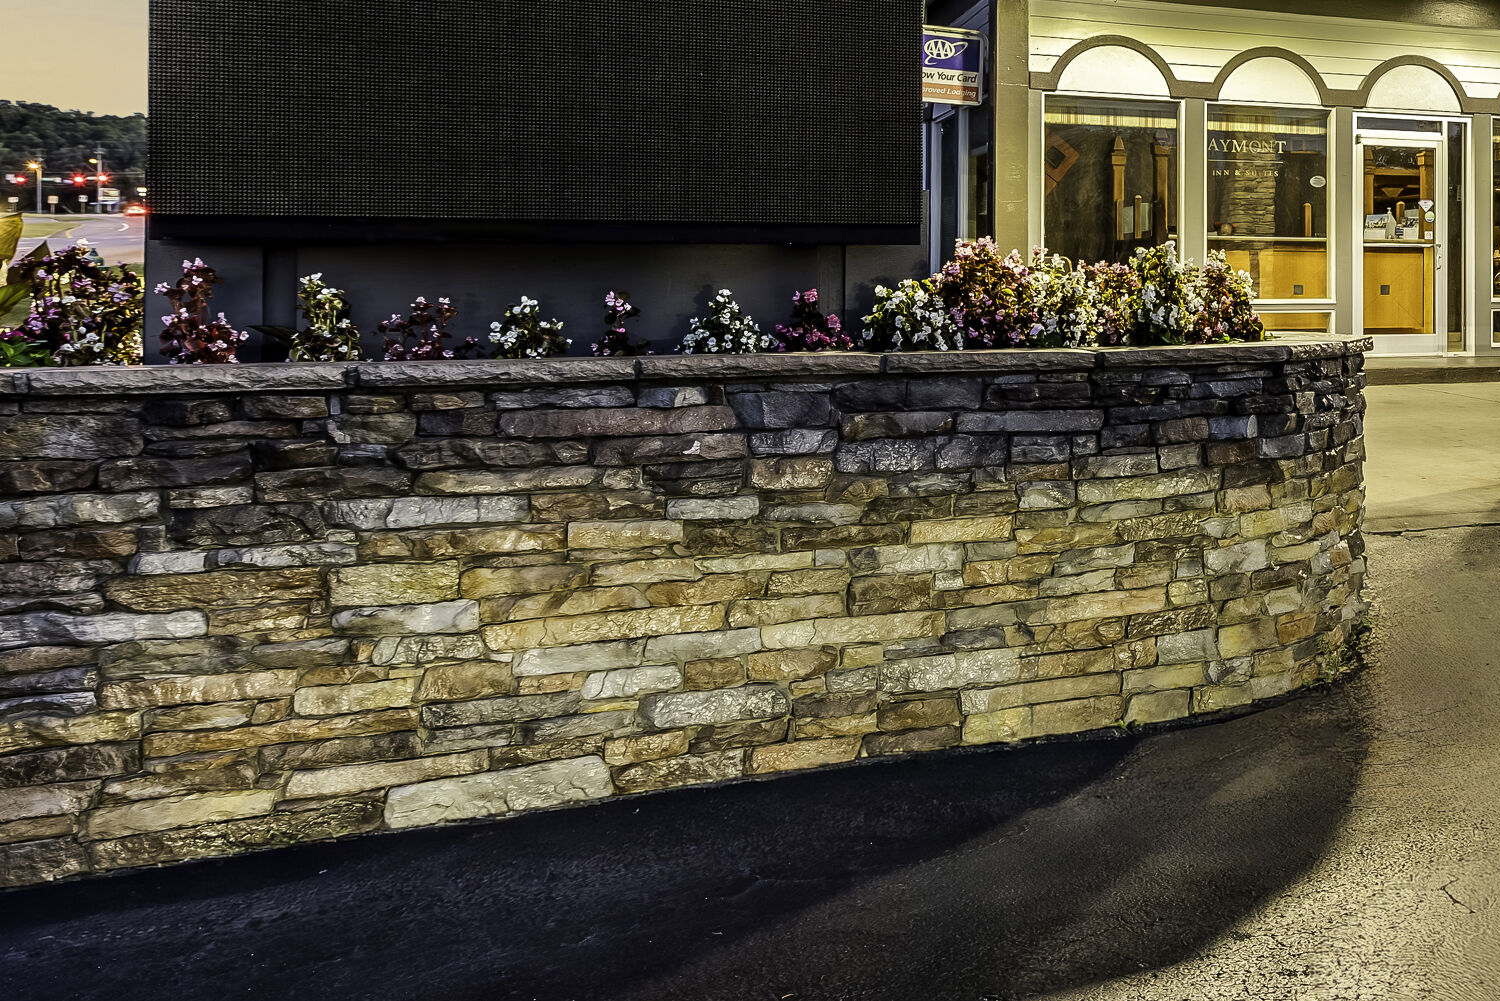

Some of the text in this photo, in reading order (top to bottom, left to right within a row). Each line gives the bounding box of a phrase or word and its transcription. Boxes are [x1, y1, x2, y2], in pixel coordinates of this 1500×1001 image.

[926, 40, 953, 58] AAA
[937, 72, 956, 81] Your
[957, 73, 978, 83] Card
[946, 88, 976, 97] Lodging
[1207, 138, 1286, 154] AYMONT
[1212, 169, 1230, 177] INN
[1245, 170, 1279, 178] SUTES
